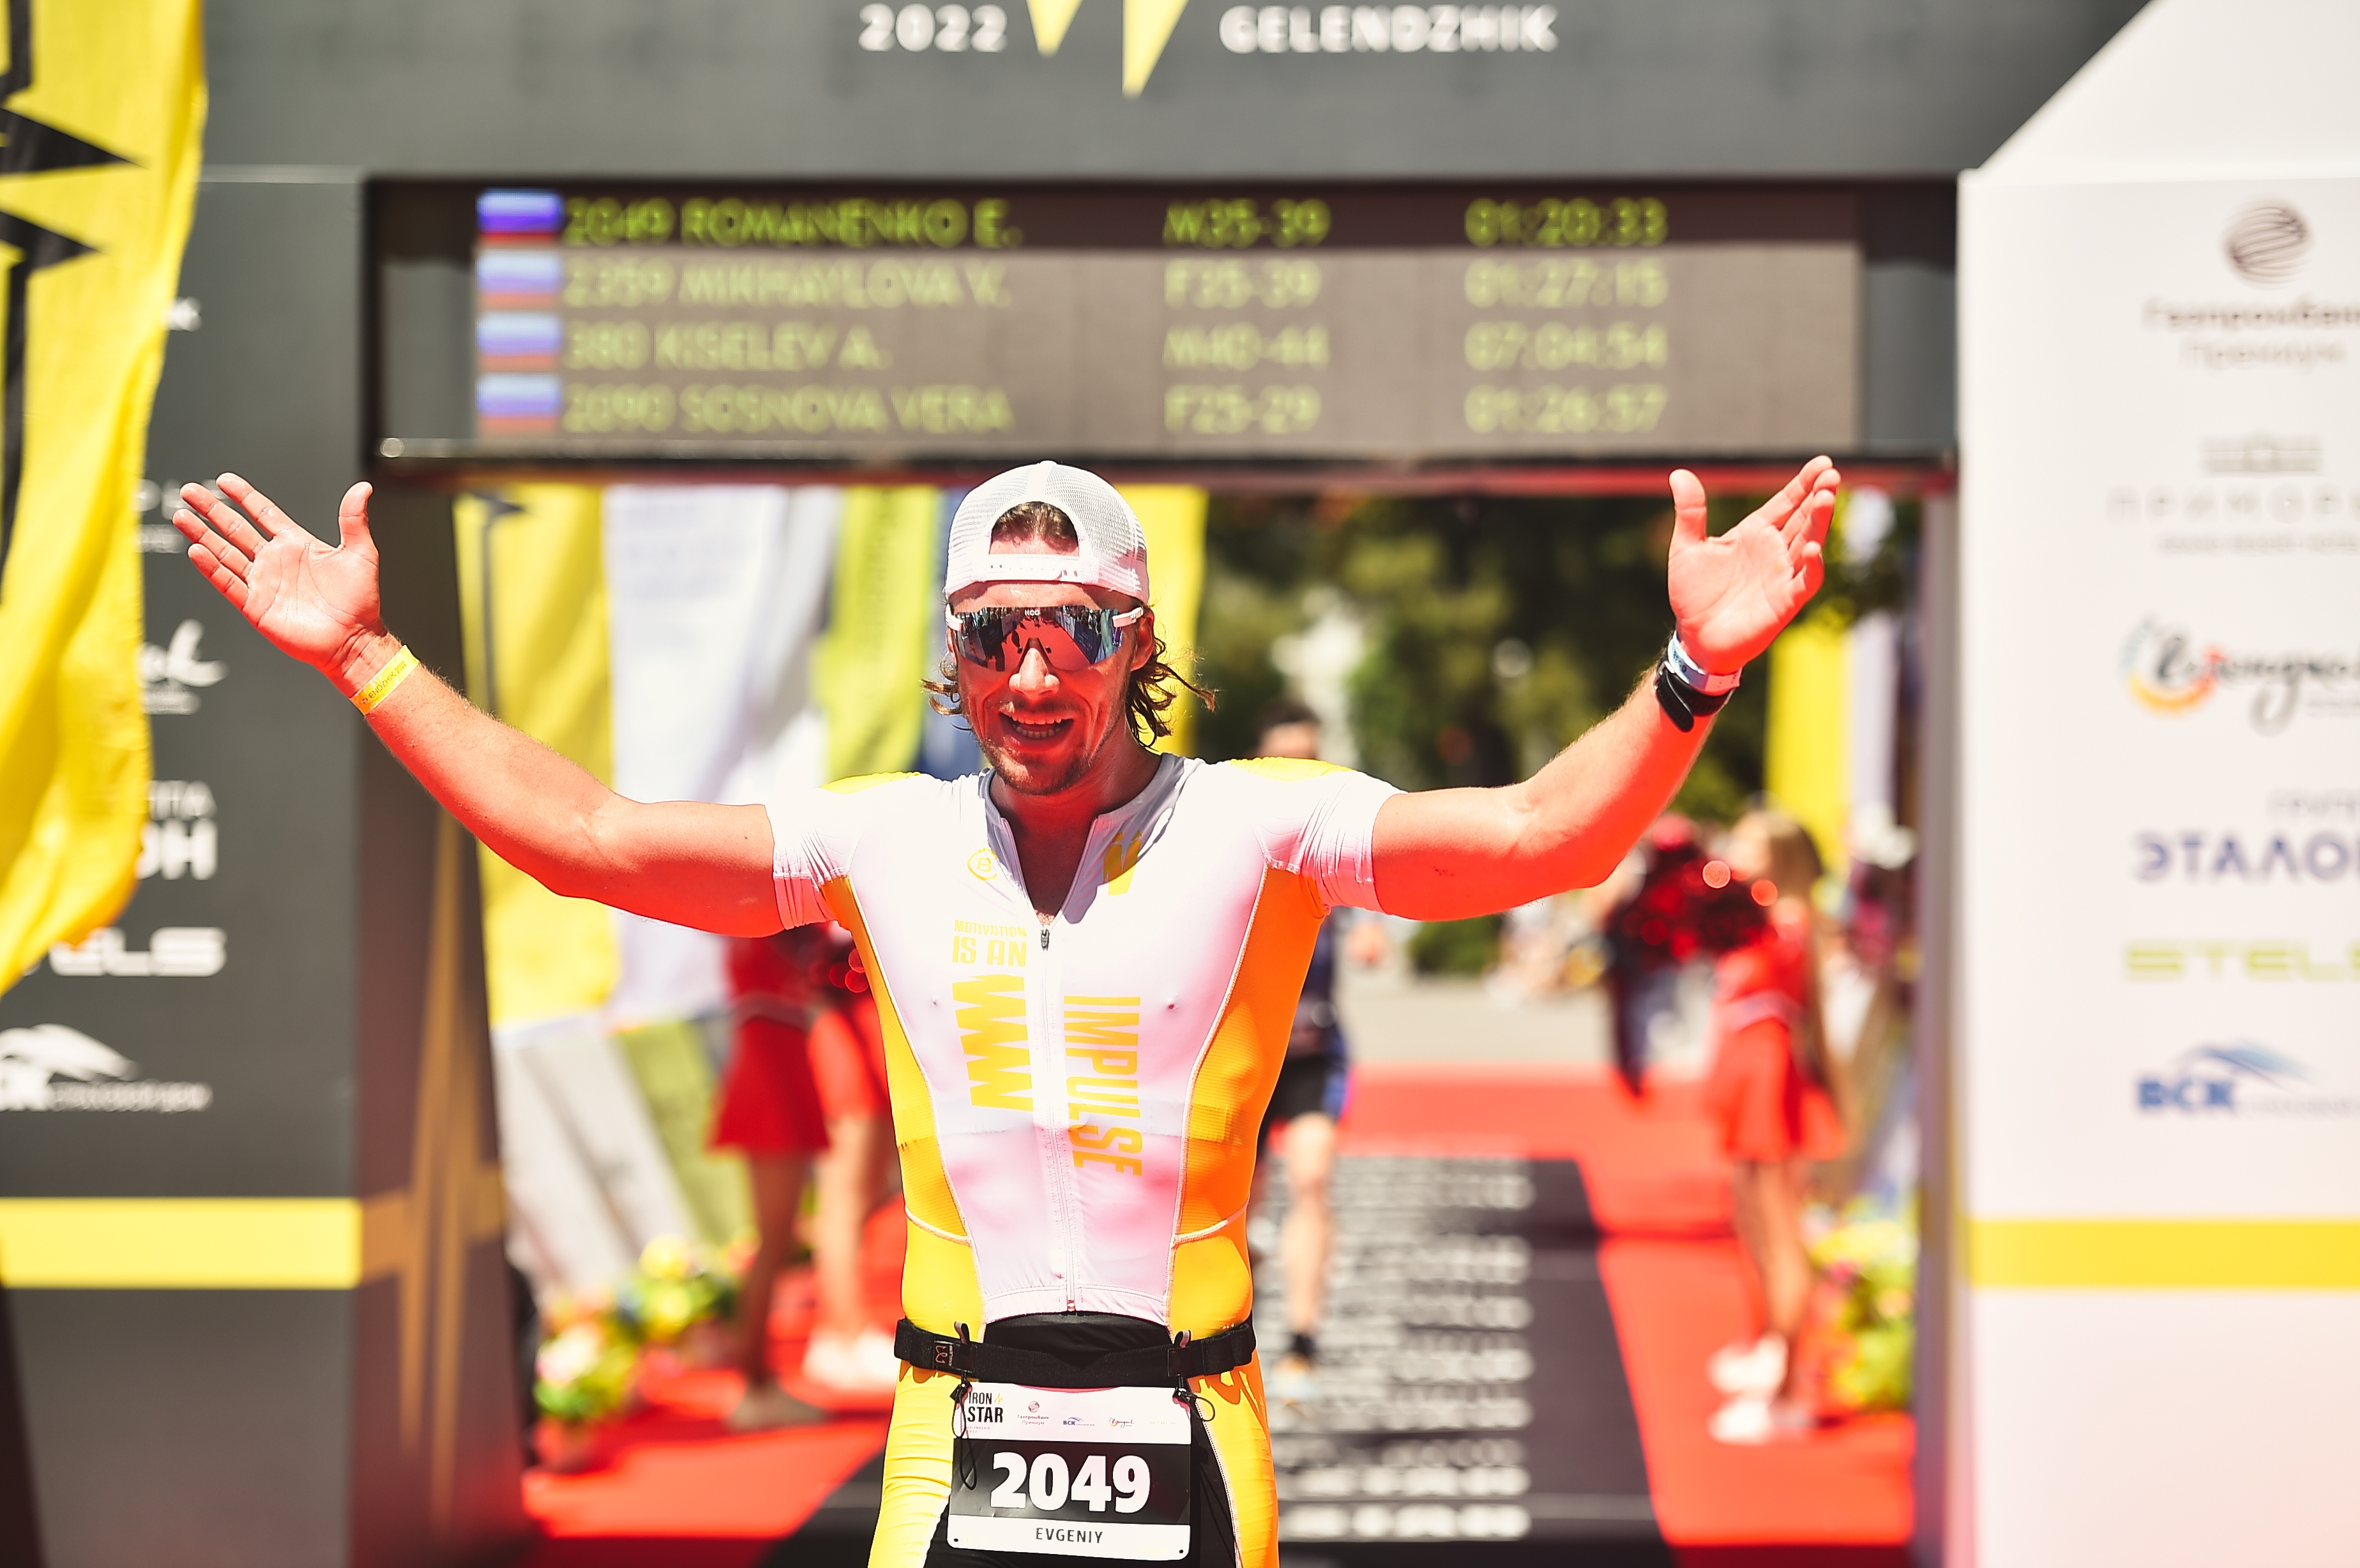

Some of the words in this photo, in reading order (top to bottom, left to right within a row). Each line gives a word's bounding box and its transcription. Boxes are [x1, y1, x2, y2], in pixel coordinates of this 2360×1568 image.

[858, 3, 1007, 52] 2022
[1220, 5, 1559, 54] GELENDZHIK
[564, 198, 674, 246] 2049
[681, 199, 968, 246] ROMANENKO
[655, 322, 838, 370] KISELEV
[681, 384, 889, 433] SOSNOVA
[891, 384, 1015, 433] VERA
[2133, 830, 2360, 882] ЭТАЛО
[953, 935, 976, 963] IS
[987, 940, 1027, 967] AN
[955, 919, 1027, 937] MOTIVATION
[1064, 996, 1142, 1176] IMPULSE
[967, 1406, 1003, 1423] STAR
[969, 1392, 992, 1405] IRON
[990, 1452, 1151, 1514] 2049
[1036, 1527, 1103, 1544] EVGENIY
